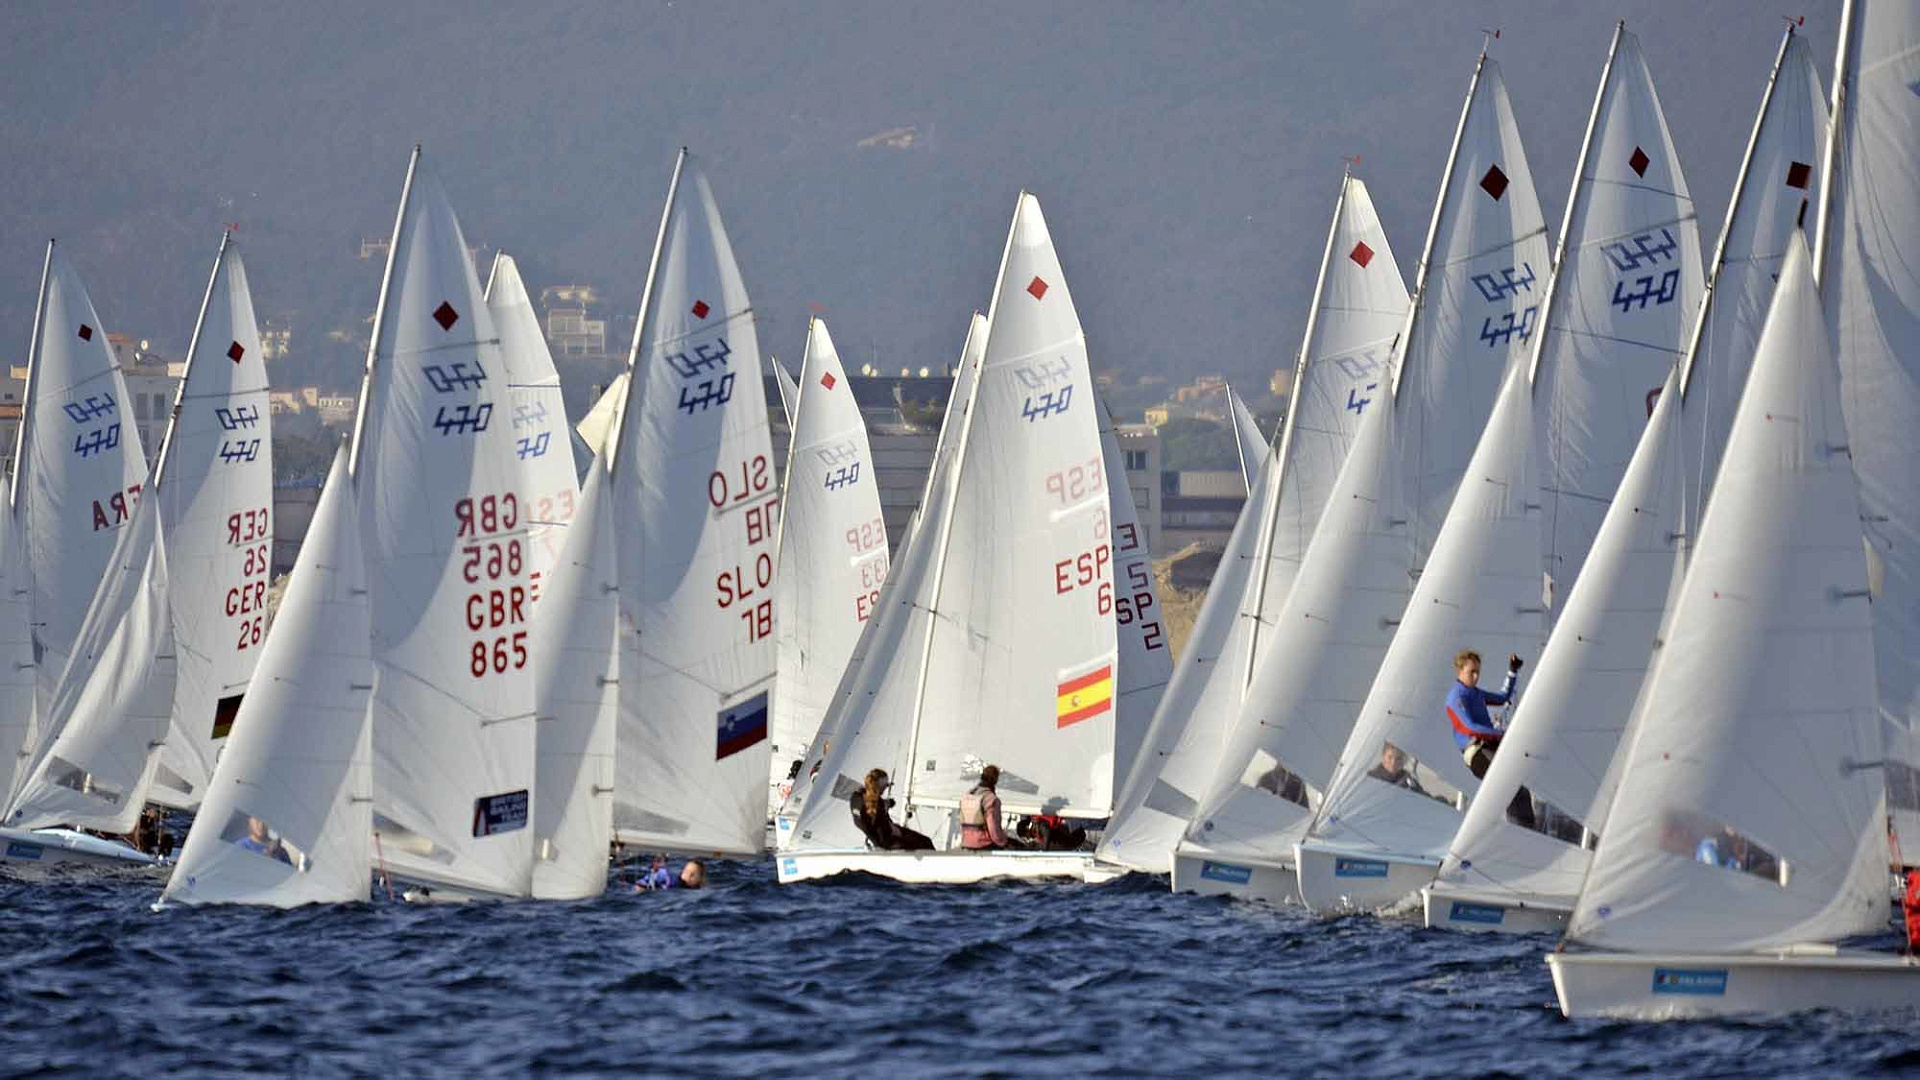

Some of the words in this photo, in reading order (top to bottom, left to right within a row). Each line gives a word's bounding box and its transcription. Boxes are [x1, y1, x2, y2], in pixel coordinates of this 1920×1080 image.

[1612, 268, 1679, 312] 470
[1479, 306, 1537, 348] 470
[678, 371, 736, 414] 470
[1022, 384, 1073, 423] 470
[434, 403, 493, 436] 470
[74, 422, 121, 457] 470
[219, 439, 261, 464] 470
[516, 432, 550, 461] 70
[824, 461, 860, 491] 470
[717, 553, 771, 608] SLO
[1055, 544, 1109, 594] ESP
[225, 581, 265, 617] GER
[466, 586, 525, 631] GBR
[1097, 582, 1112, 616] 6
[1115, 592, 1153, 625] SP
[237, 616, 262, 651] 26
[1141, 621, 1163, 651] 2
[471, 631, 528, 678] 865
